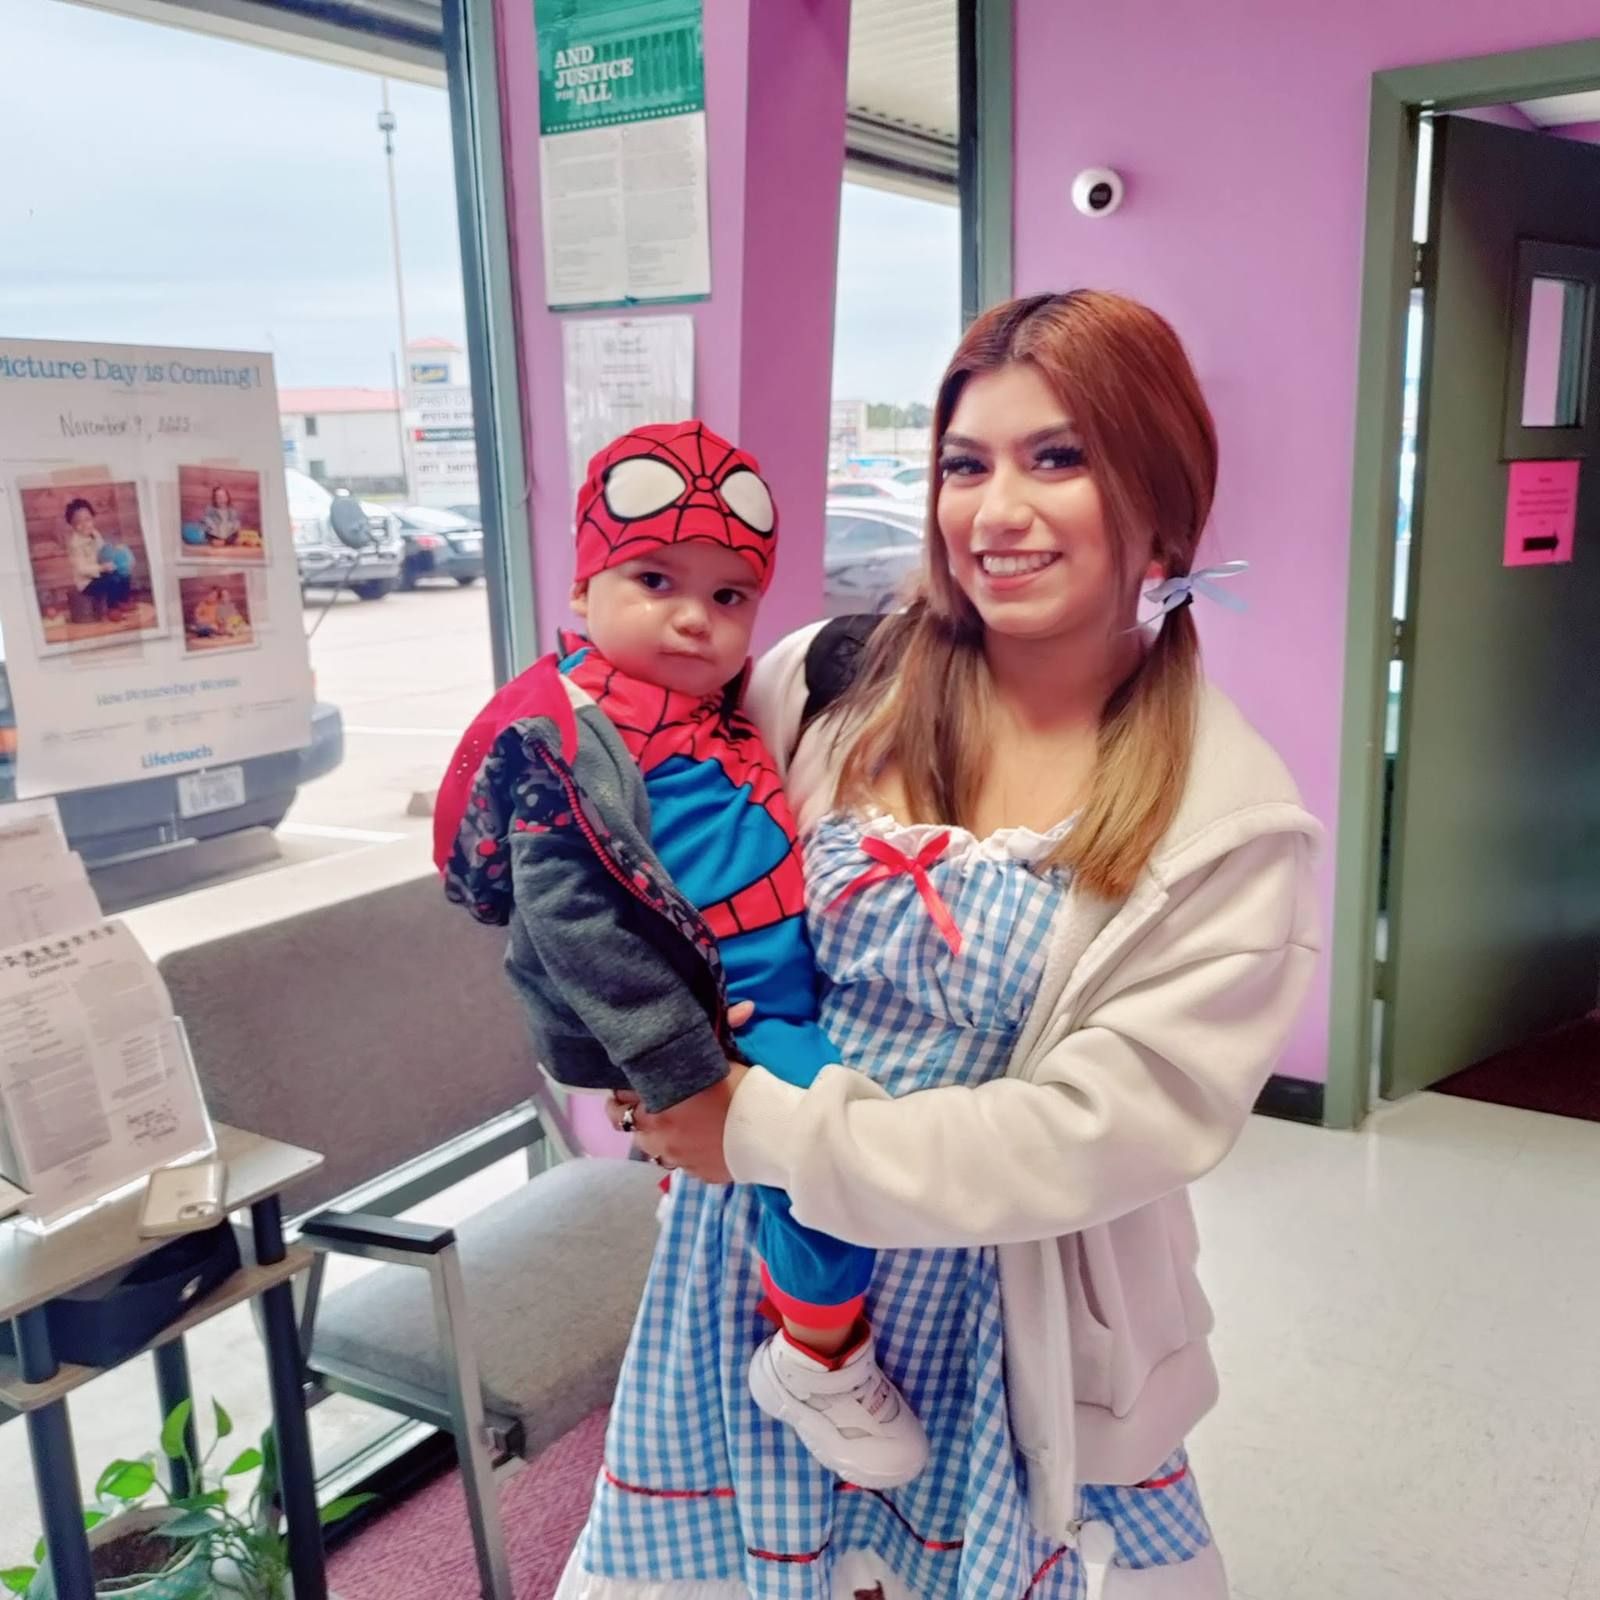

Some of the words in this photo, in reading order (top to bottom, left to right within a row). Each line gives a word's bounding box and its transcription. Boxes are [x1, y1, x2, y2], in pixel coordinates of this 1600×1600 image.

[555, 45, 594, 69] AND
[555, 57, 633, 88] JUSTICE
[576, 82, 612, 105] ALL
[93, 358, 138, 386] Day
[146, 362, 163, 382] is
[141, 744, 213, 768] Lifetouch
